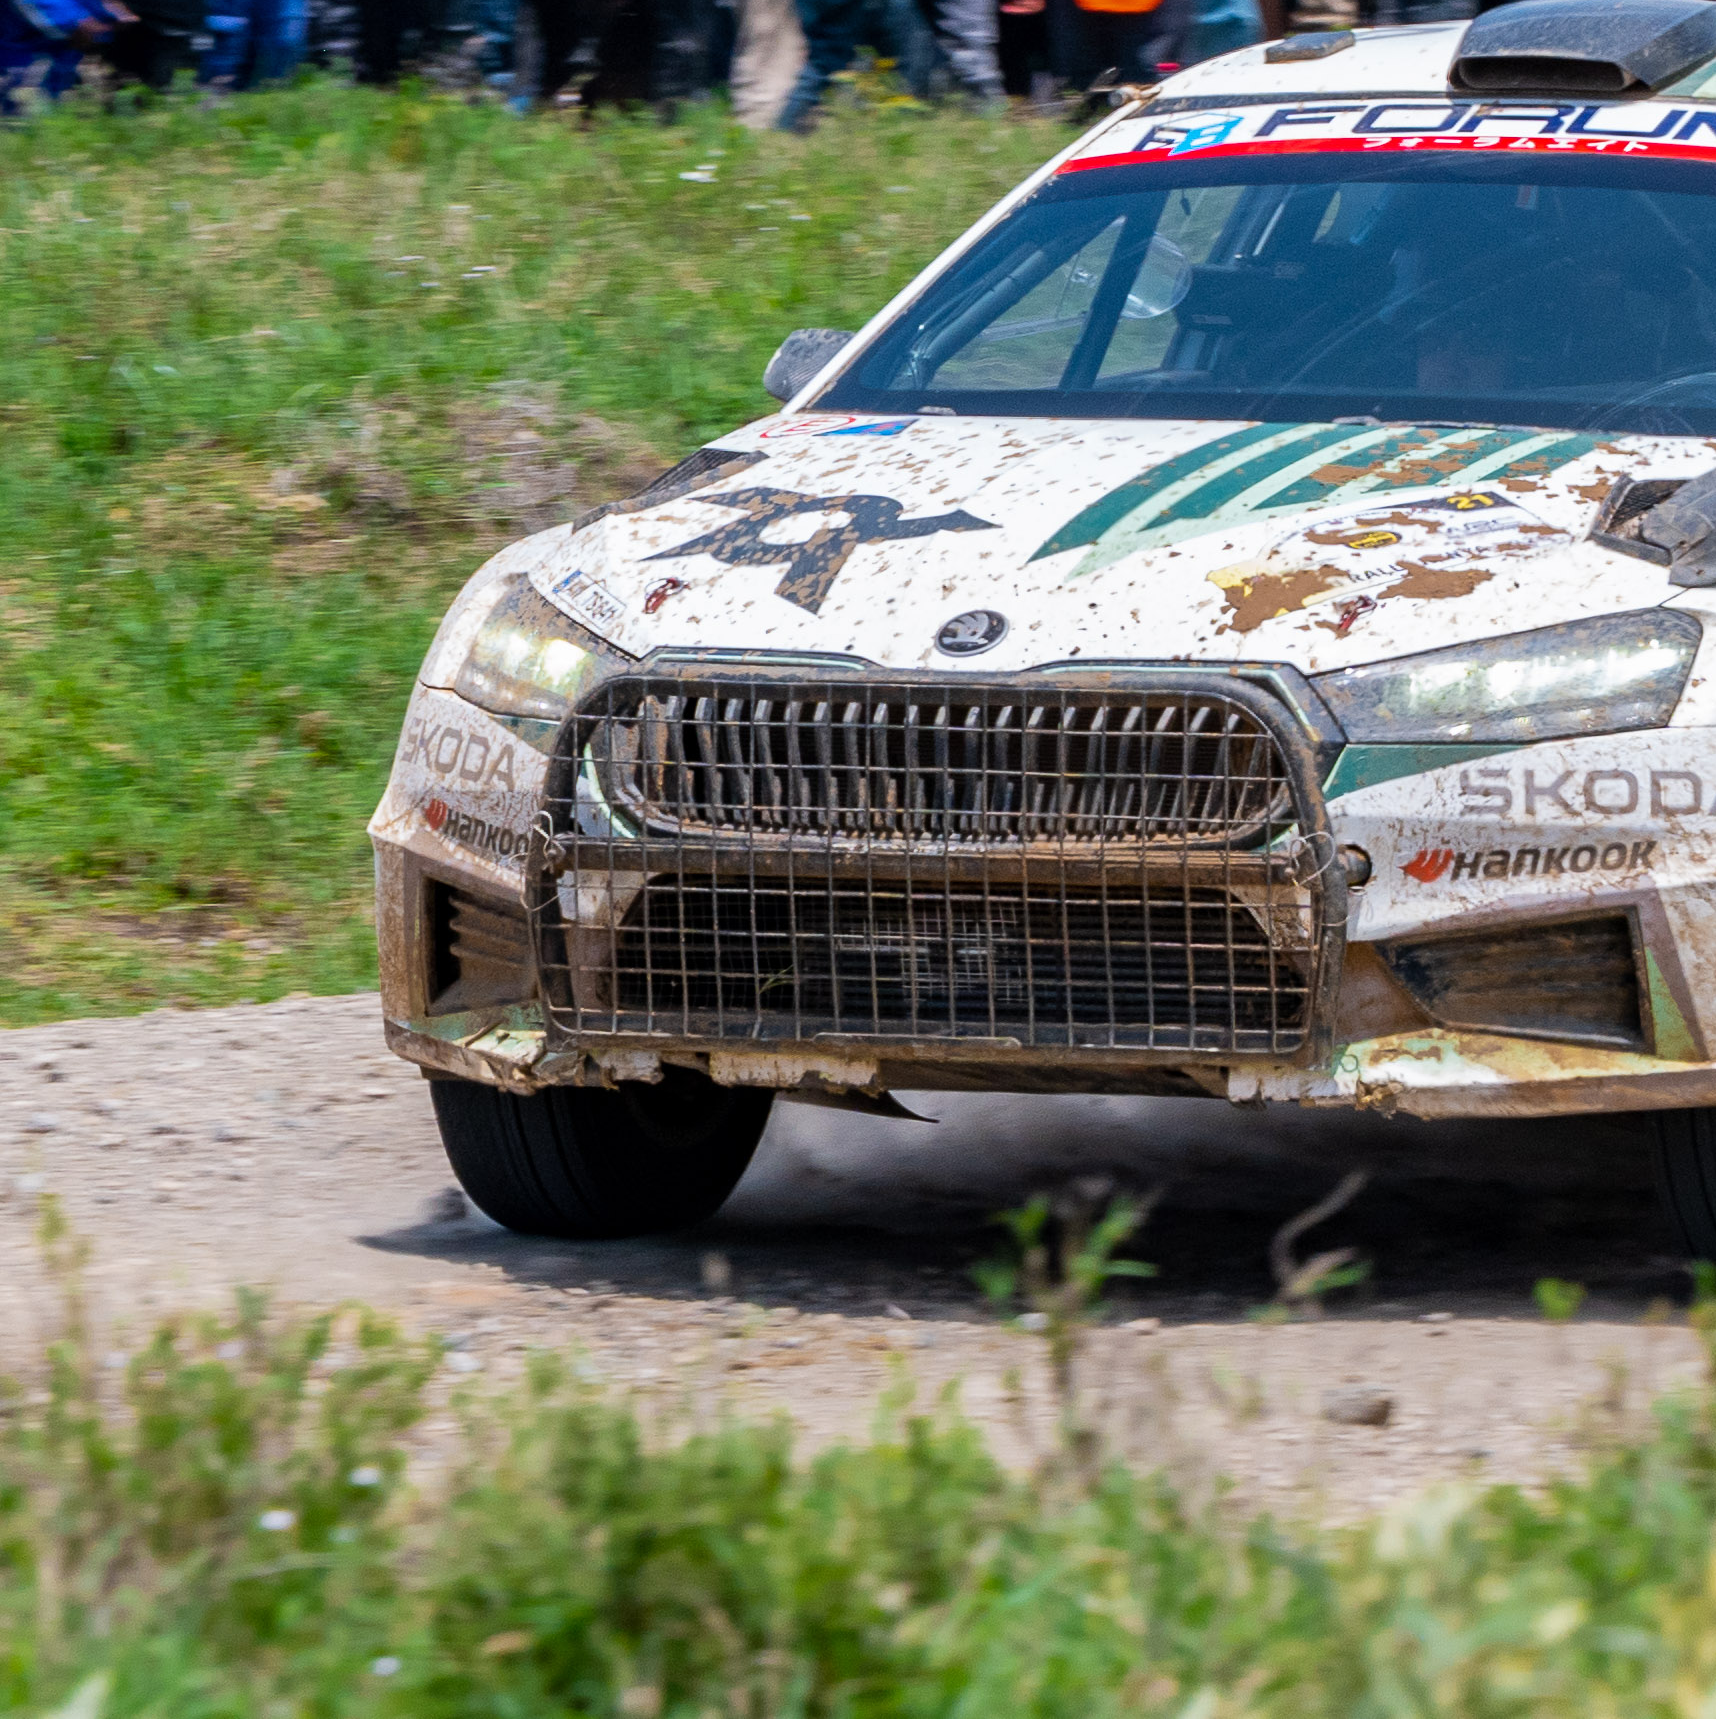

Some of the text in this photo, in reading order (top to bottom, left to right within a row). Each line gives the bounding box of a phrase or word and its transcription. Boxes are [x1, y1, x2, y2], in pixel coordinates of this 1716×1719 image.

[1362, 135, 1649, 153] フォーラムエイト
